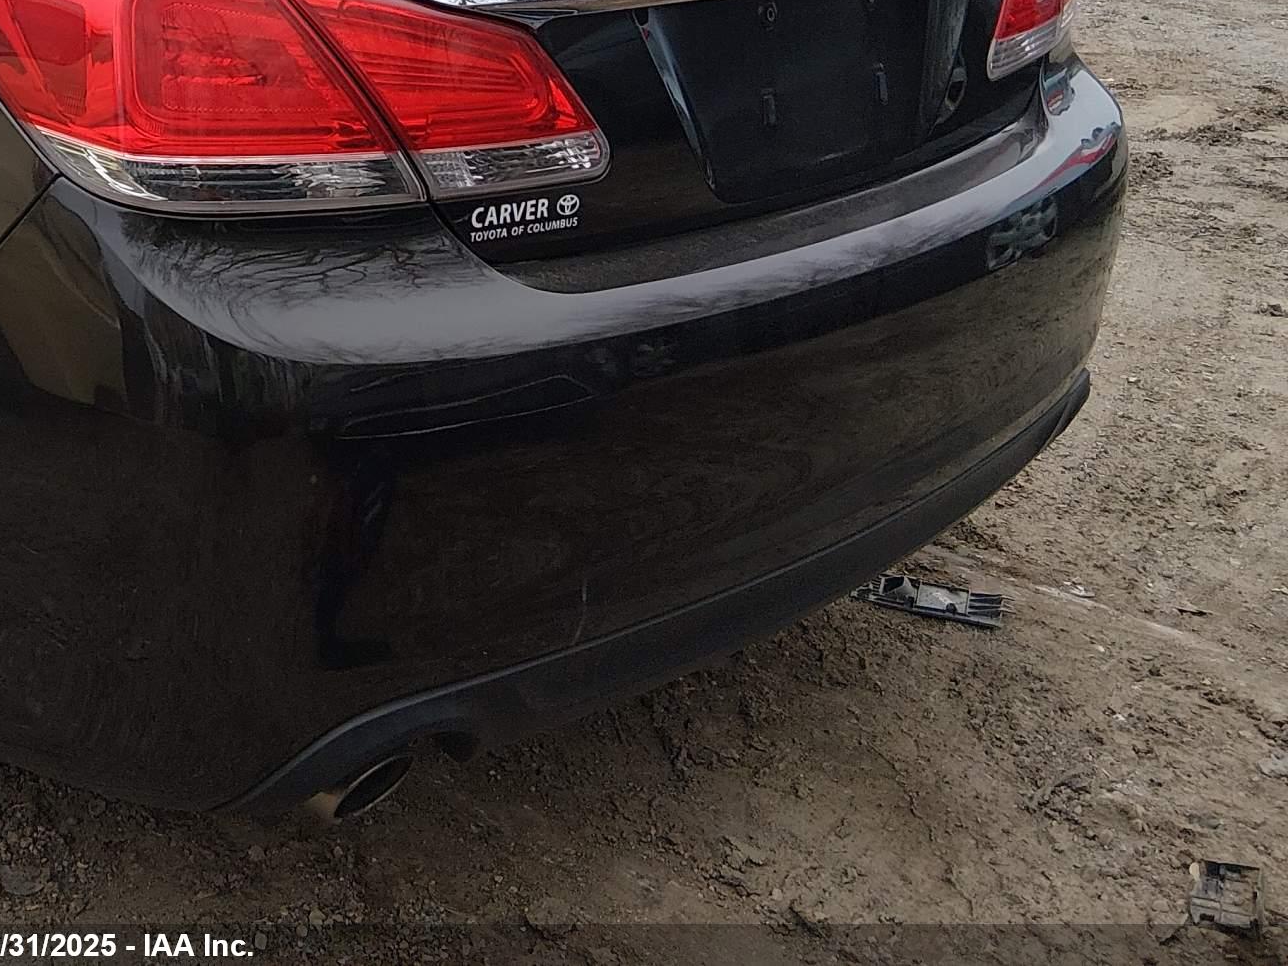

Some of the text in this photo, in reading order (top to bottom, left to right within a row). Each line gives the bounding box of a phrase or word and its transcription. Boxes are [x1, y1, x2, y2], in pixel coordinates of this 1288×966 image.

[471, 198, 549, 228] CARVER
[470, 217, 579, 243] TOYOTA OF COLUMBUS
